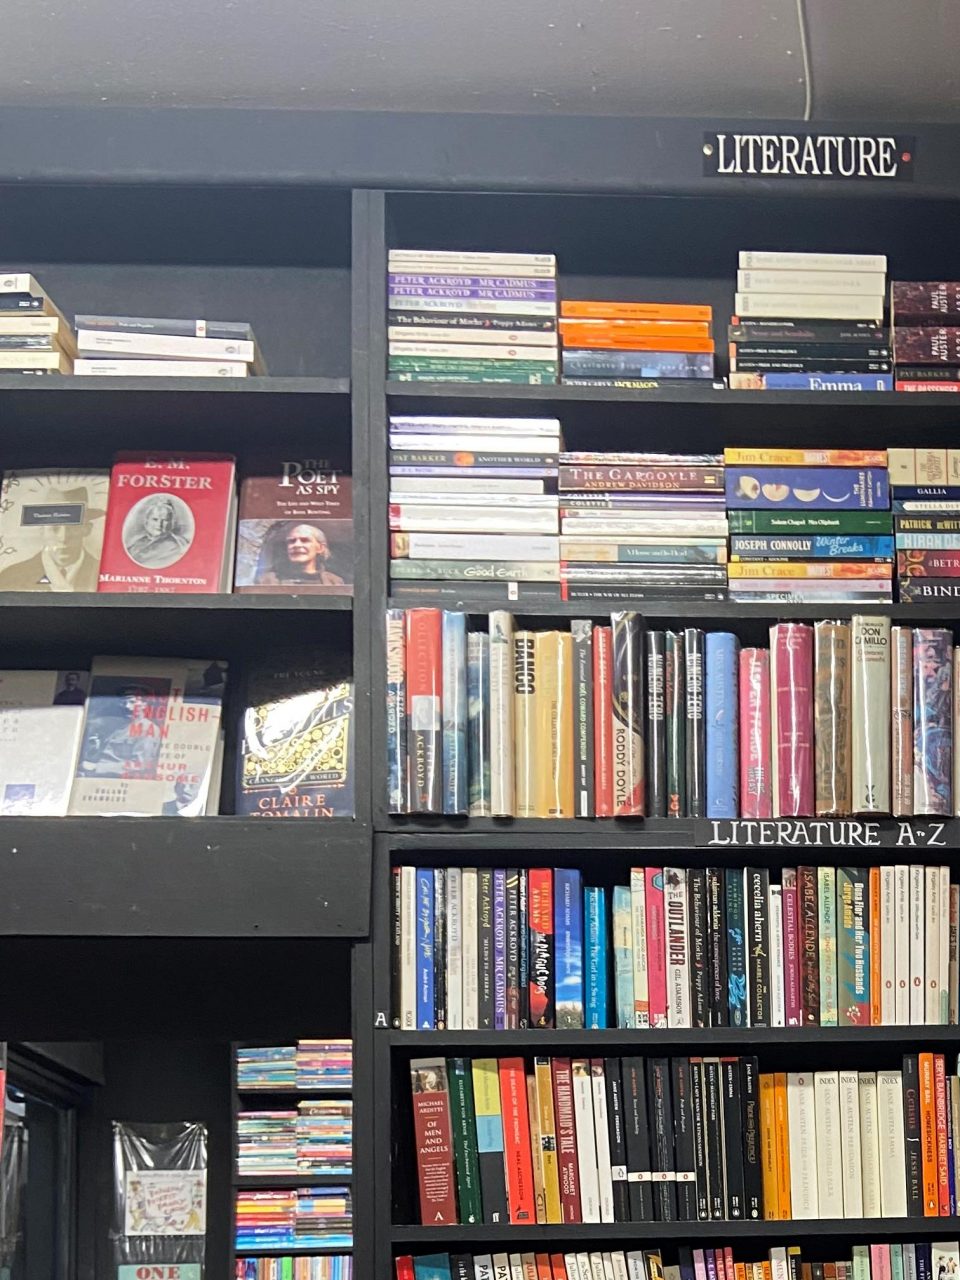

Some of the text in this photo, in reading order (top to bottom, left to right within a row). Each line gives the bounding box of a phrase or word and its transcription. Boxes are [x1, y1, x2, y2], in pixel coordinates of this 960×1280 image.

[717, 135, 897, 176] LITERATURE
[394, 276, 537, 288] PETER ACKROYD MR CADMUS
[940, 283, 948, 314] AUSTER
[809, 378, 863, 391] Emma
[303, 458, 329, 469] THE
[117, 473, 214, 490] FORSTER
[278, 461, 340, 487] POET
[569, 466, 698, 482] THE GARGOYLE
[295, 484, 340, 496] AS SPY
[584, 481, 680, 490] ANDREW DAVIDSON
[917, 487, 947, 496] GALLIA
[900, 519, 933, 531] PATRICK
[734, 539, 812, 551] JOSEPH CONNOLLY
[816, 535, 851, 547] Winter
[828, 543, 864, 556] Breaks
[99, 573, 207, 585] MARIANNE THORNTON
[515, 639, 536, 695] BANCO
[416, 734, 424, 787] ACKROYD
[615, 728, 626, 807] RODDY DOYLE
[258, 797, 326, 808] CLAIRE
[708, 821, 880, 845] LITERATURE
[753, 873, 764, 941] cecelia ahern
[804, 871, 815, 958] ISABEL ALLENDE
[668, 901, 686, 966] OUTLANDER
[495, 874, 504, 1013] PETER ACKROYD MR CADMUS
[374, 1012, 388, 1027] A
[555, 1069, 574, 1154] THE HANDMAID'S TALE
[562, 1167, 570, 1195] ATWOOD
[136, 1266, 180, 1280] ONE
